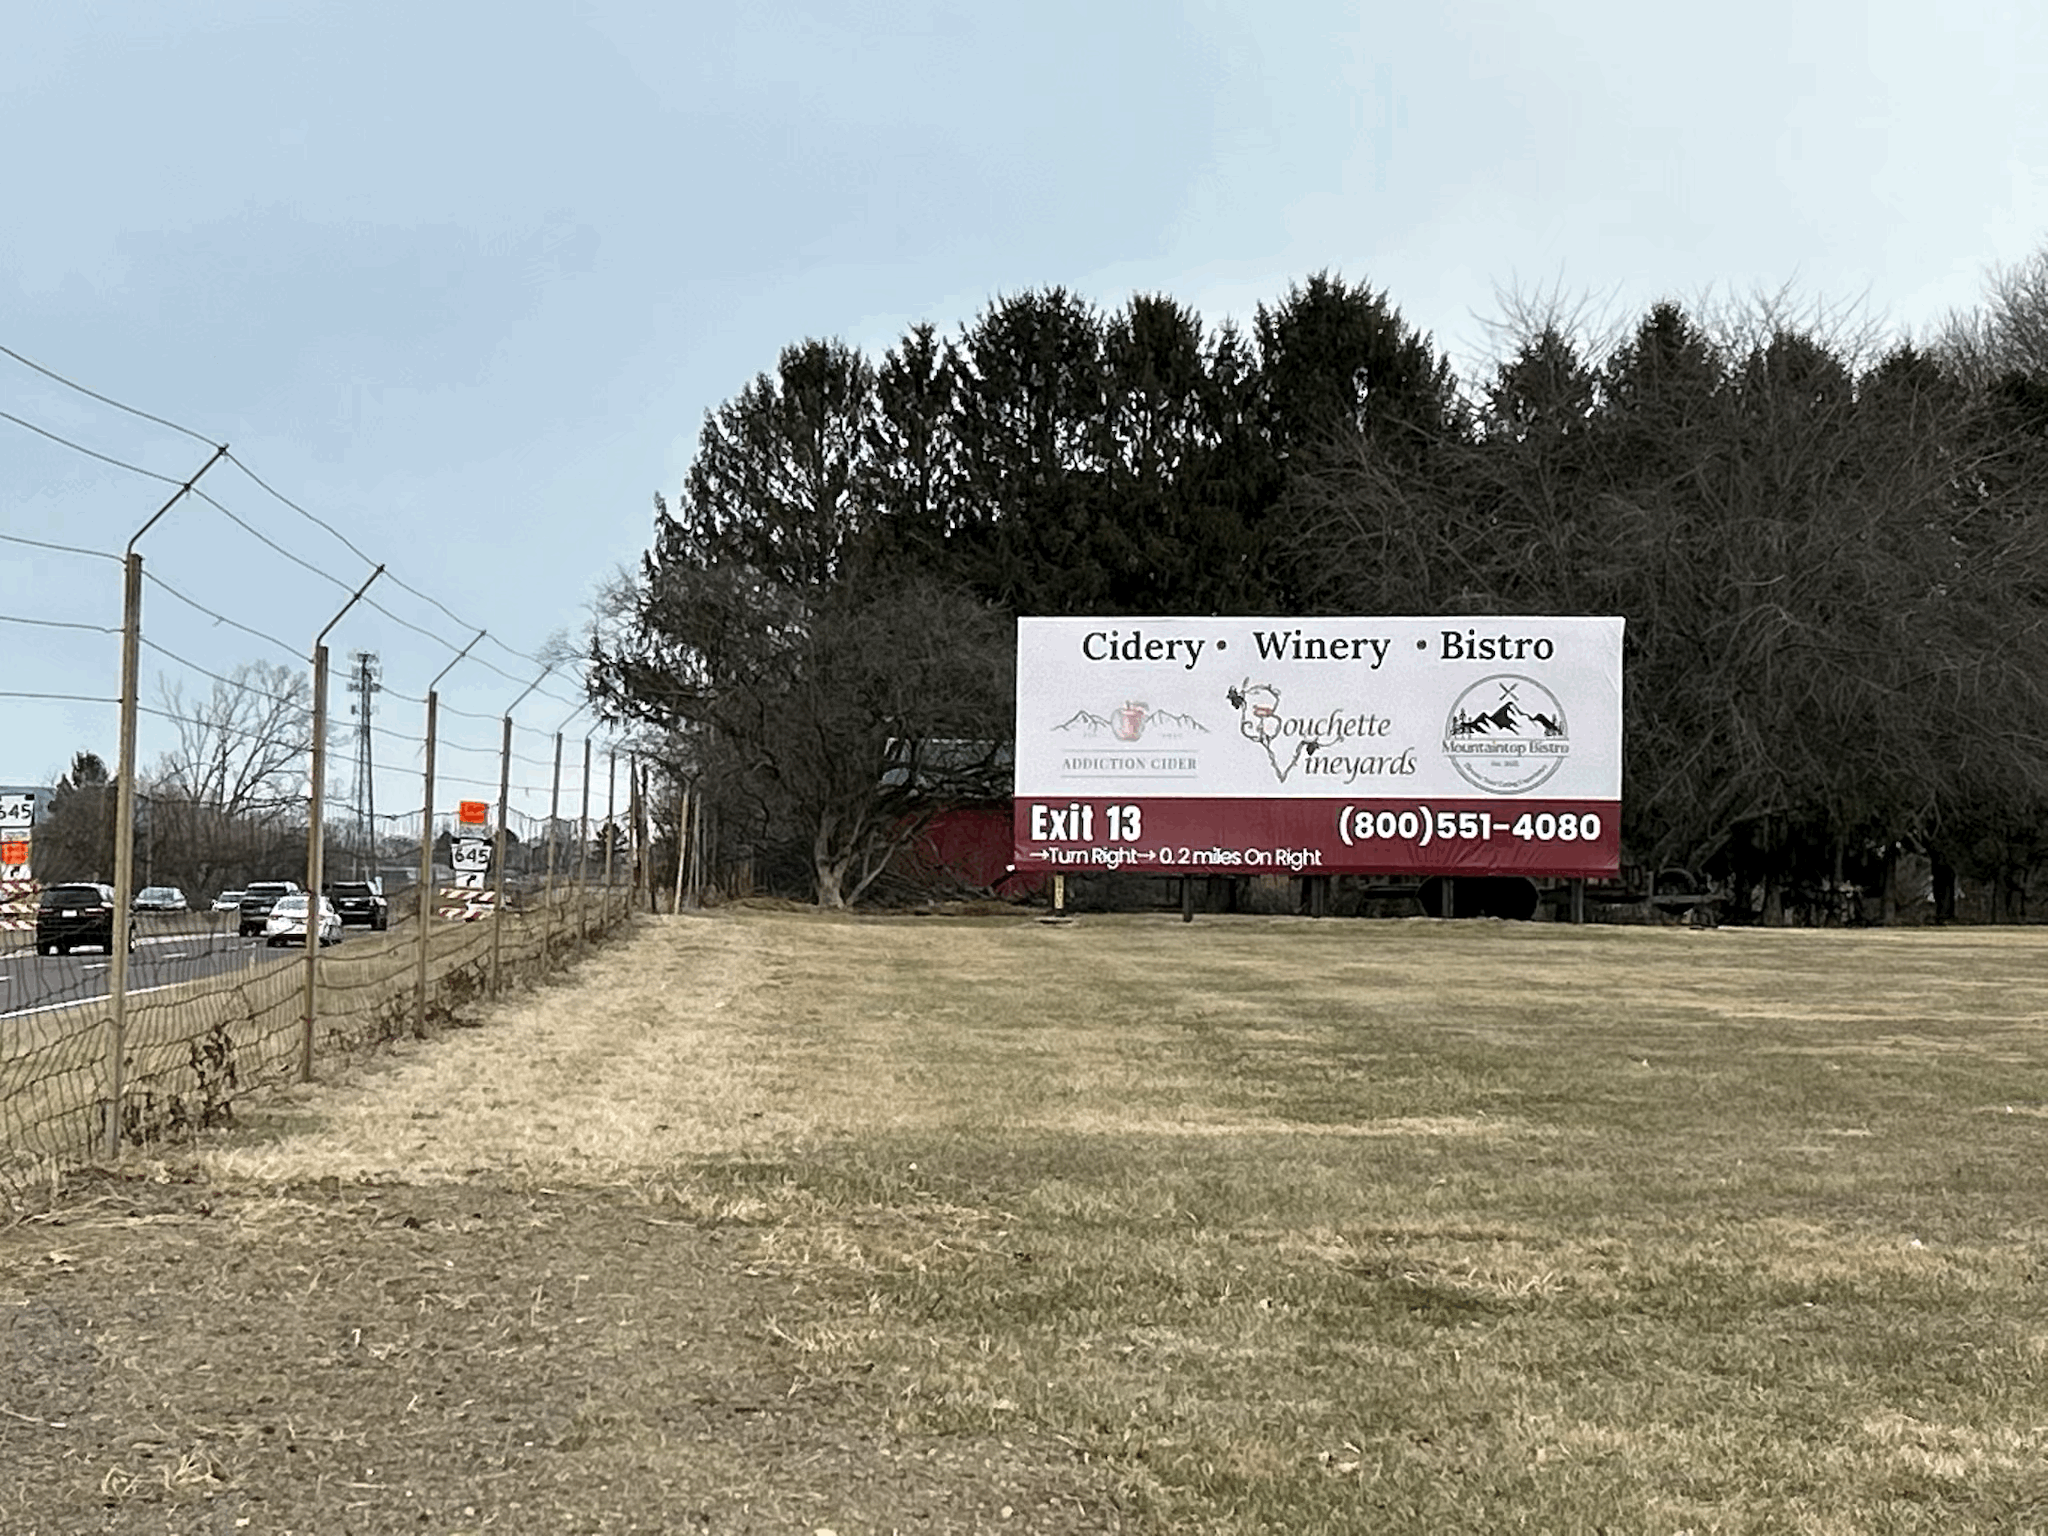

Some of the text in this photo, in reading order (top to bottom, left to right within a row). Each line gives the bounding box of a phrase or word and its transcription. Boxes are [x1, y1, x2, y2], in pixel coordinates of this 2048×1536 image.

[1083, 628, 1554, 669] Cidery Winery Bistro
[1240, 684, 1391, 742] Bouchette
[1062, 758, 1197, 770] ADDICTION CIDER
[1260, 742, 1417, 784] Vineyards
[1442, 739, 1570, 757] Mountaintop Bistro
[1032, 803, 1141, 841] Exit 13
[1339, 806, 1601, 846] (800)551-4080
[455, 848, 488, 864] 645
[1049, 847, 1322, 870] Turn Right 0.2 miles On Right
